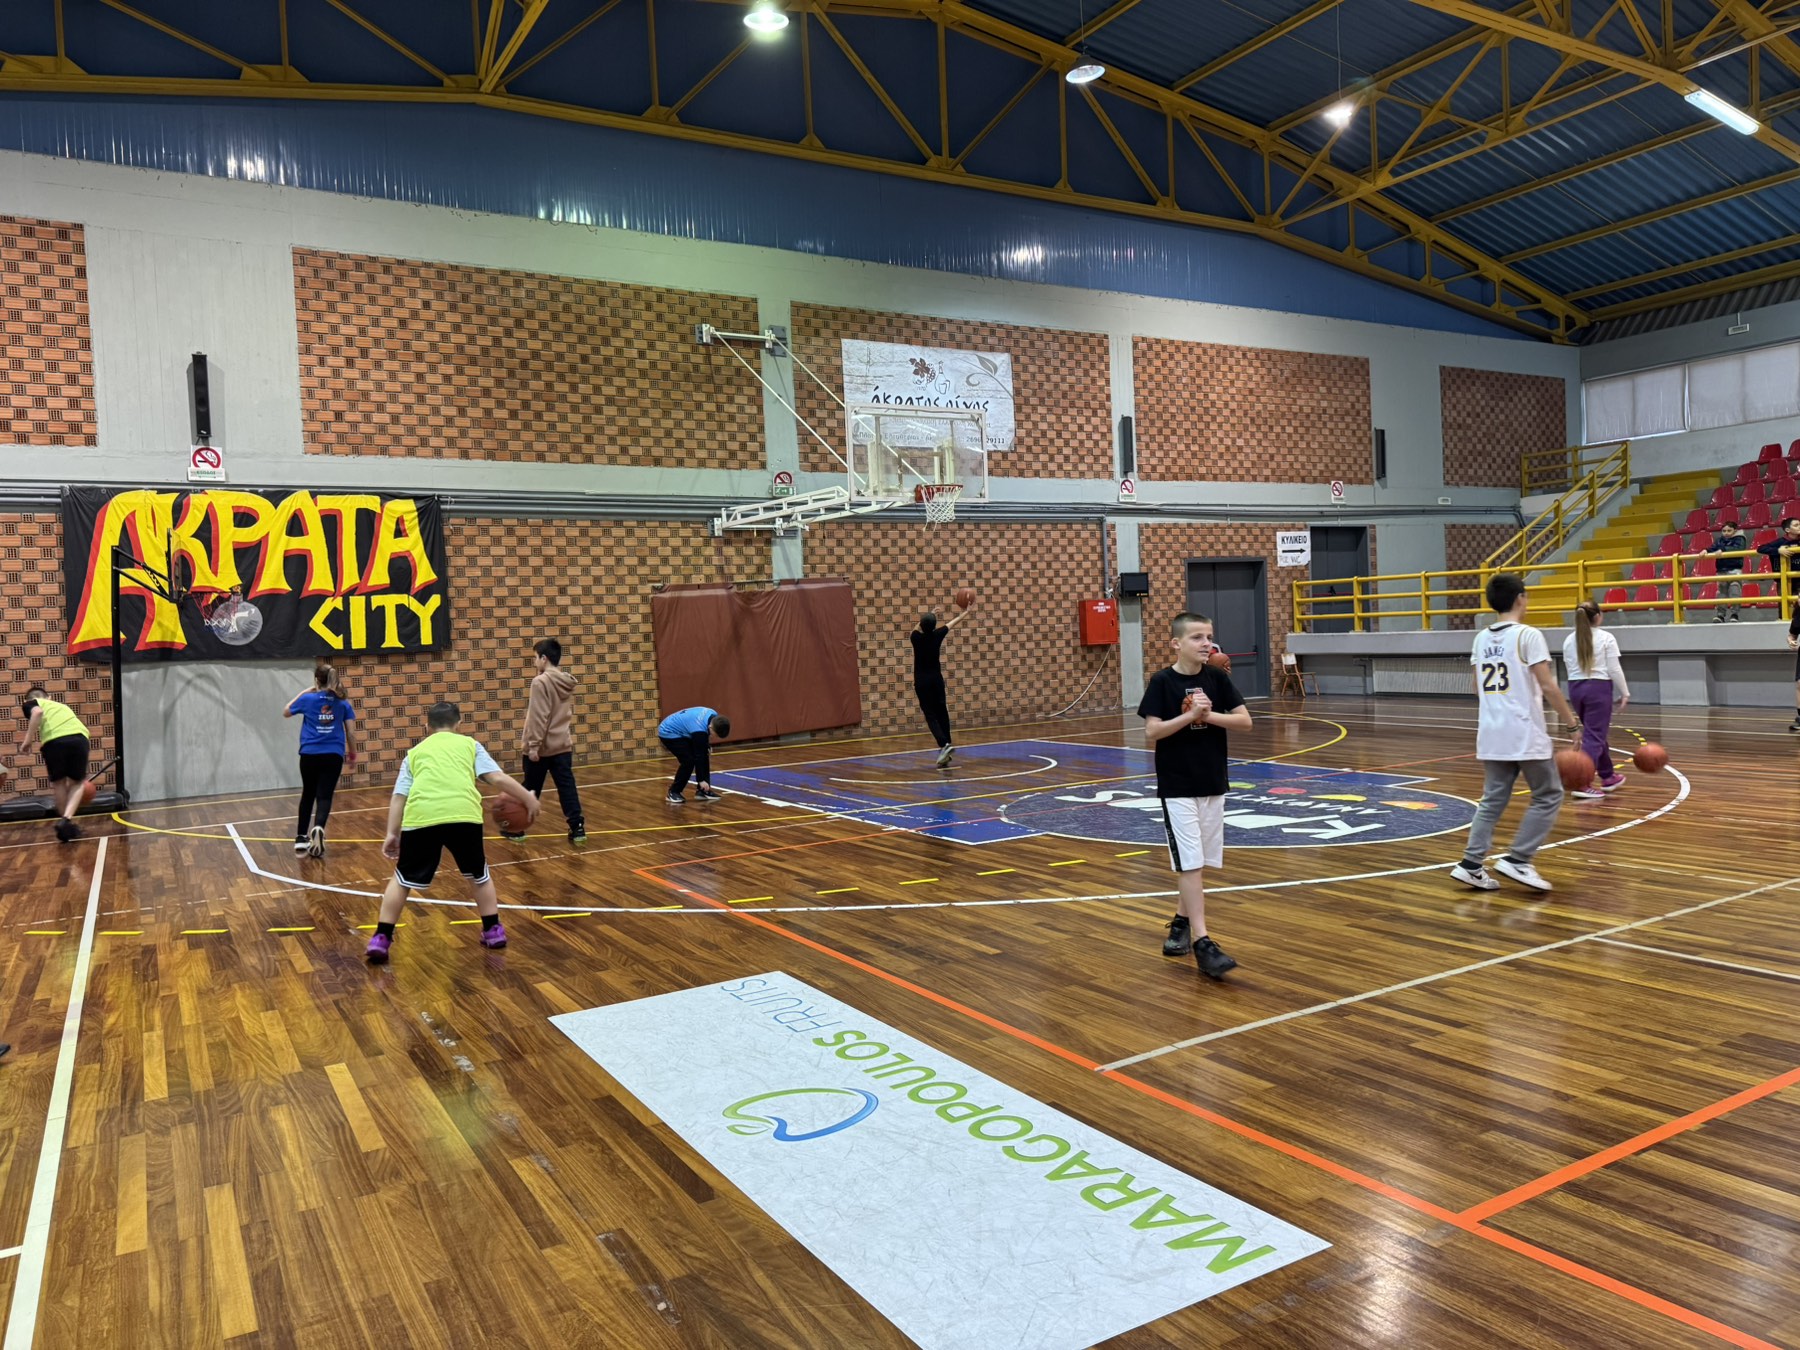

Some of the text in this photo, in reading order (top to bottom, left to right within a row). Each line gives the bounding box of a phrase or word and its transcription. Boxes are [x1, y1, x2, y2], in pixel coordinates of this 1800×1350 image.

[309, 593, 441, 650] CITY
[1481, 661, 1511, 695] 23
[721, 978, 843, 1033] FRUITS
[812, 1030, 1278, 1275] MARAGOPOULOS
